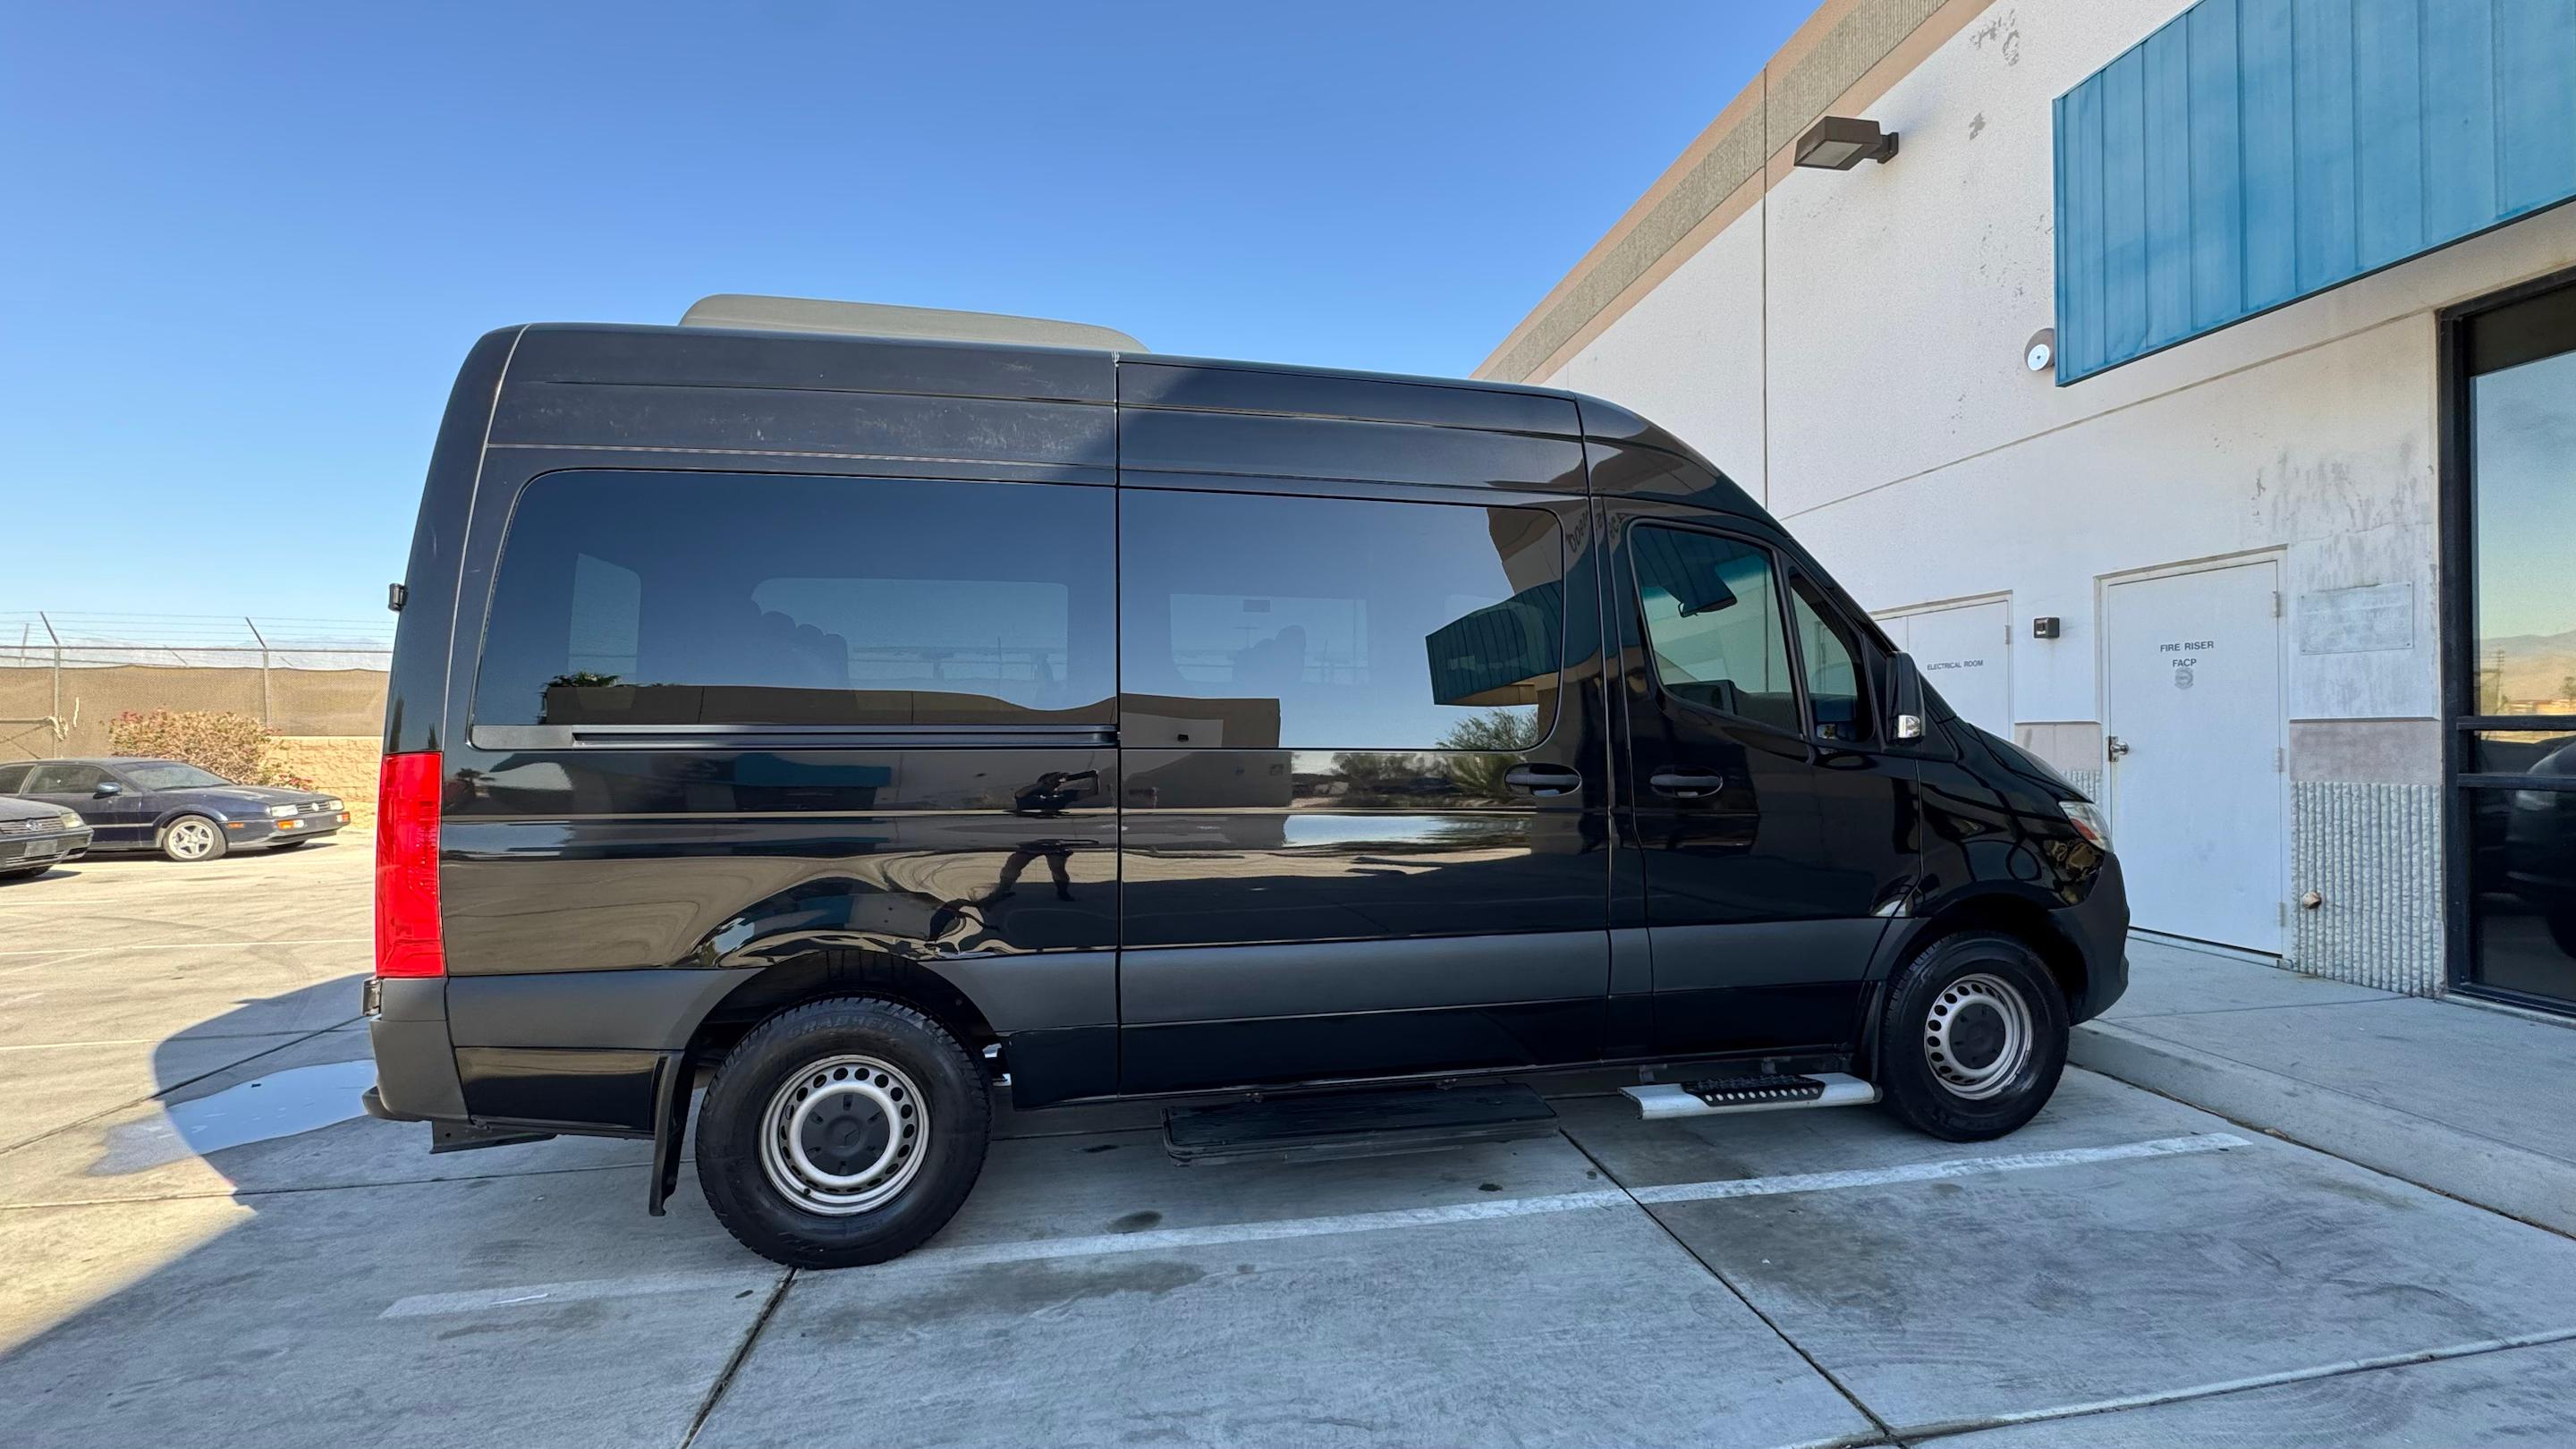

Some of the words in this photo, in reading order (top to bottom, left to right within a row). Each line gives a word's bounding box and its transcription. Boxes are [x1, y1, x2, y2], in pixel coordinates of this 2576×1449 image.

[2160, 643, 2181, 652] FIRE
[2184, 640, 2214, 650] RISER
[1927, 662, 1962, 670] ELECTRICAL
[2173, 658, 2197, 667] FACP
